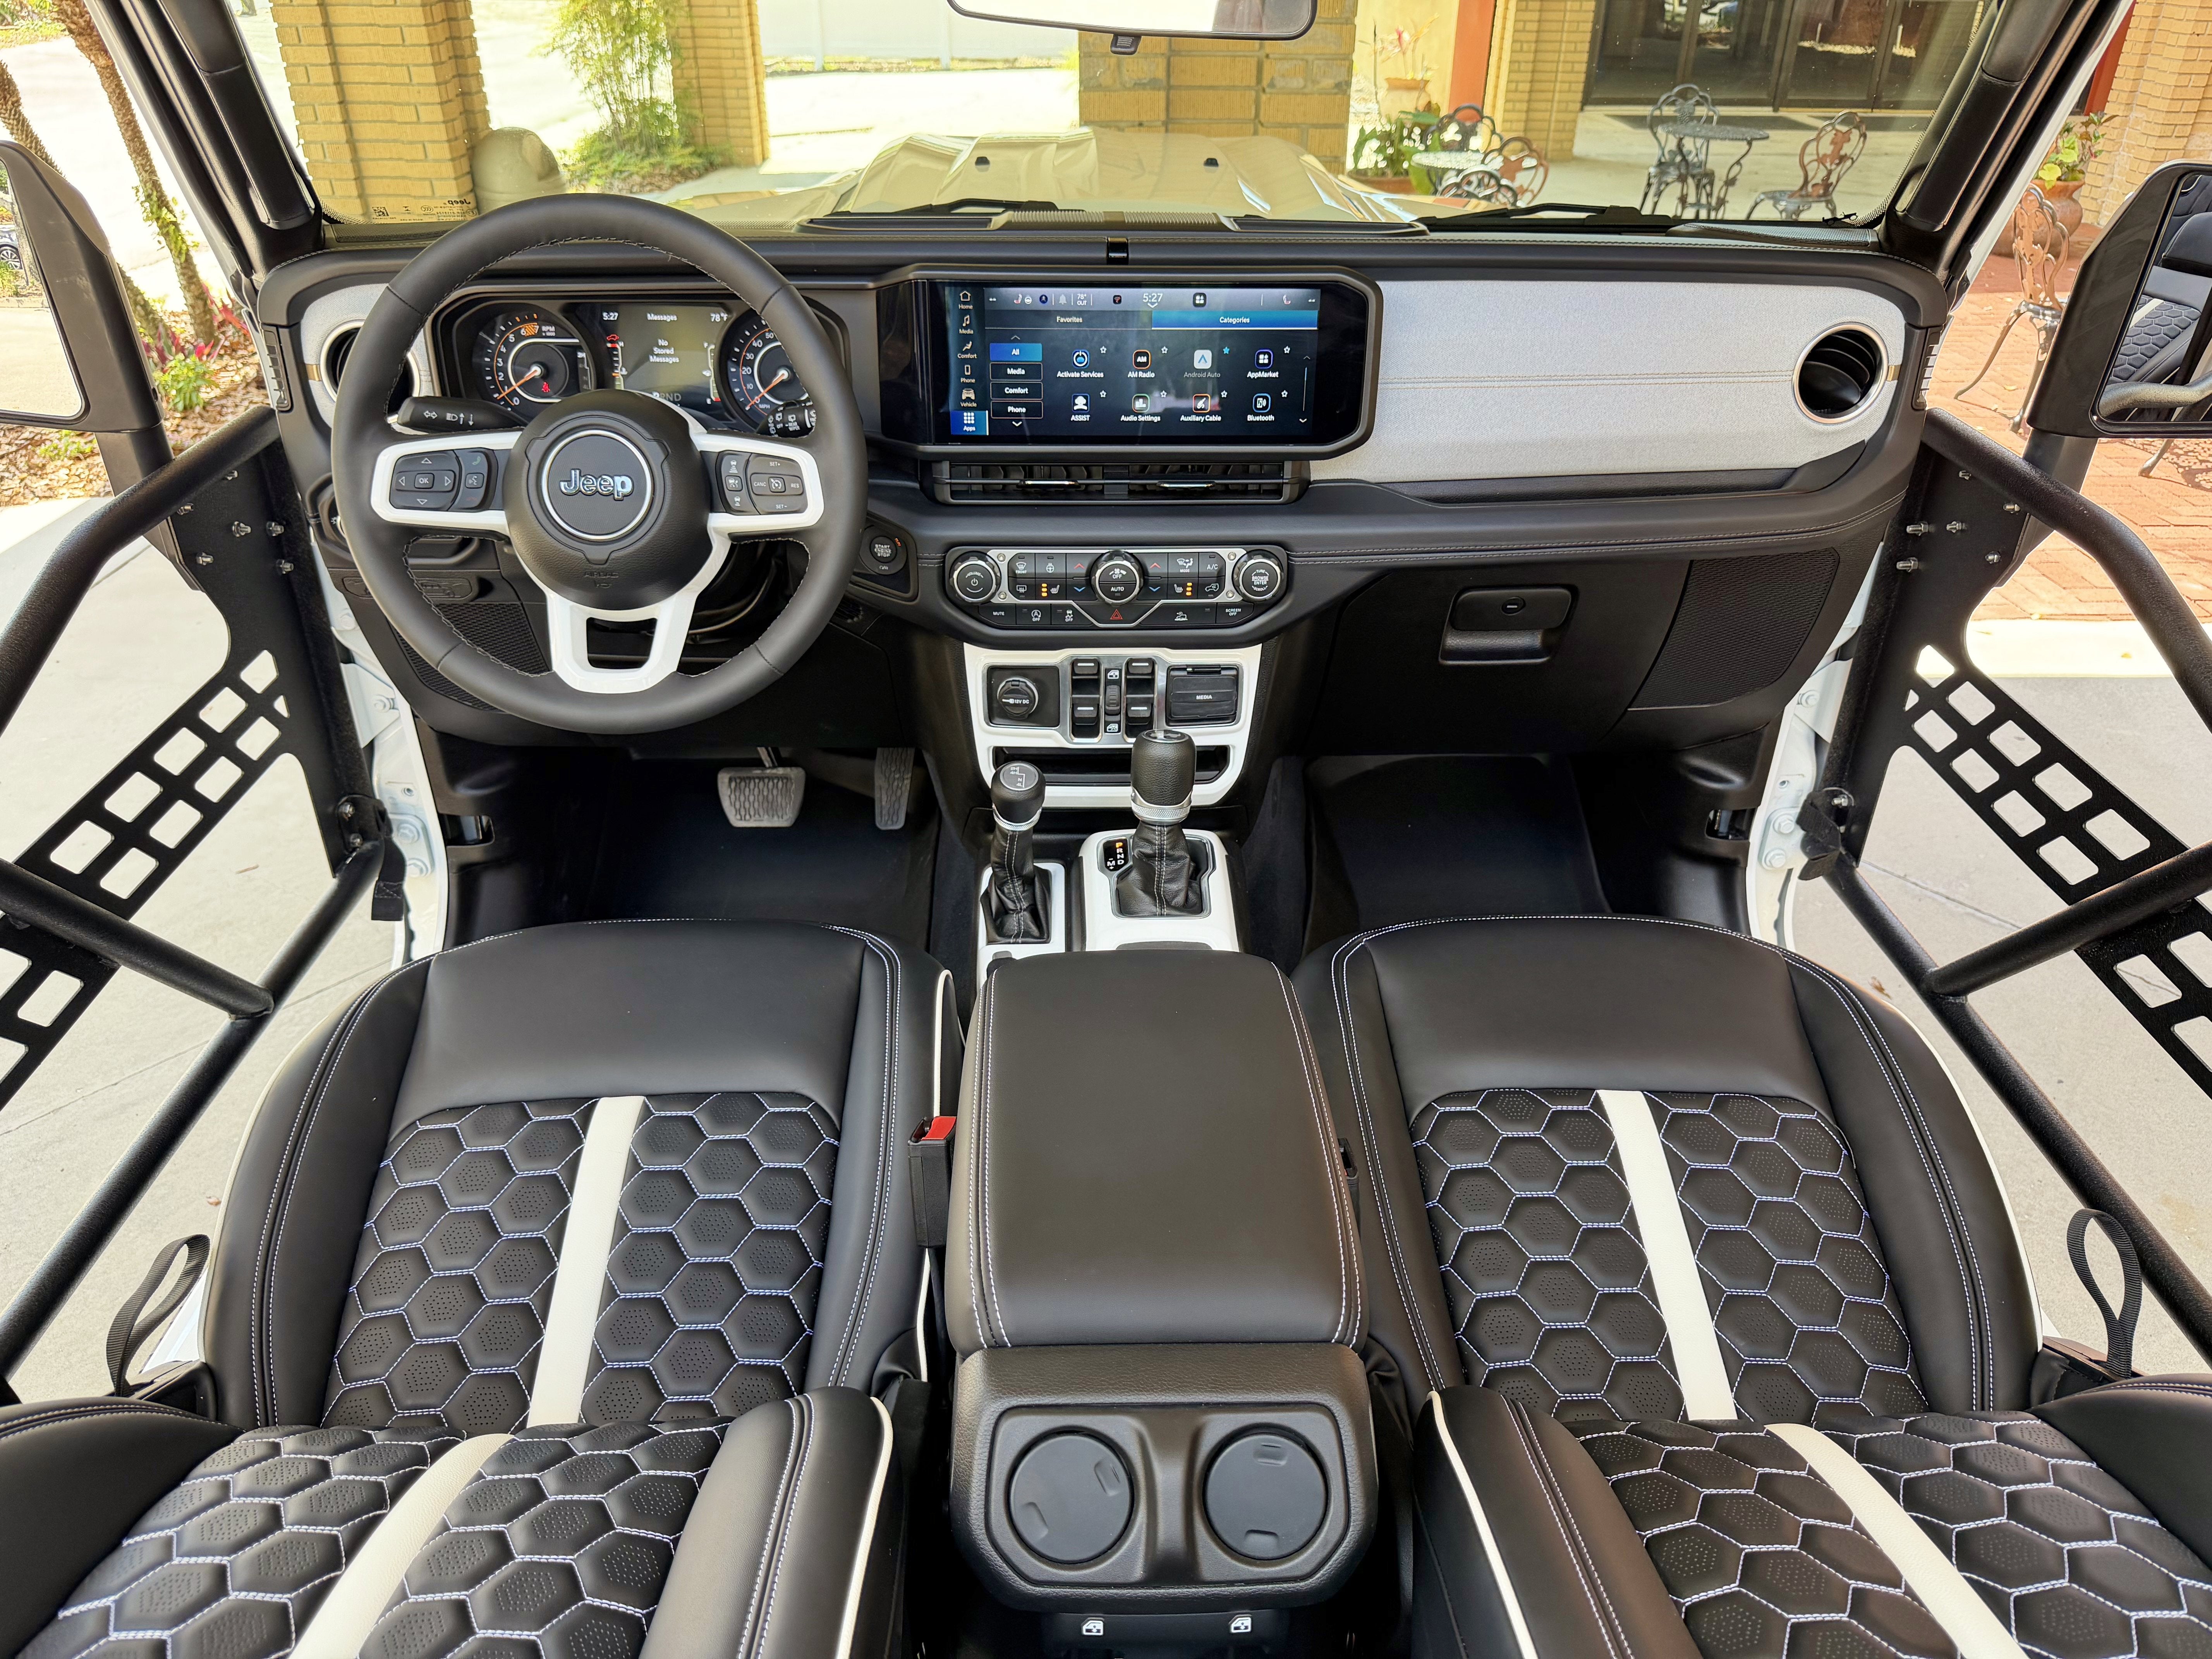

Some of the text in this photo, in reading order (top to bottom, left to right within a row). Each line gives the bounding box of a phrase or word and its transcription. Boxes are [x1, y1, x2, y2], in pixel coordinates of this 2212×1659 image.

[1143, 294, 1163, 302] 5:27
[602, 312, 619, 321] 5:27
[647, 313, 678, 322] Messages
[752, 339, 763, 347] 40
[653, 346, 674, 354] Stored
[648, 354, 679, 364] Messages
[514, 397, 520, 405] 0
[560, 468, 634, 501] Jeep
